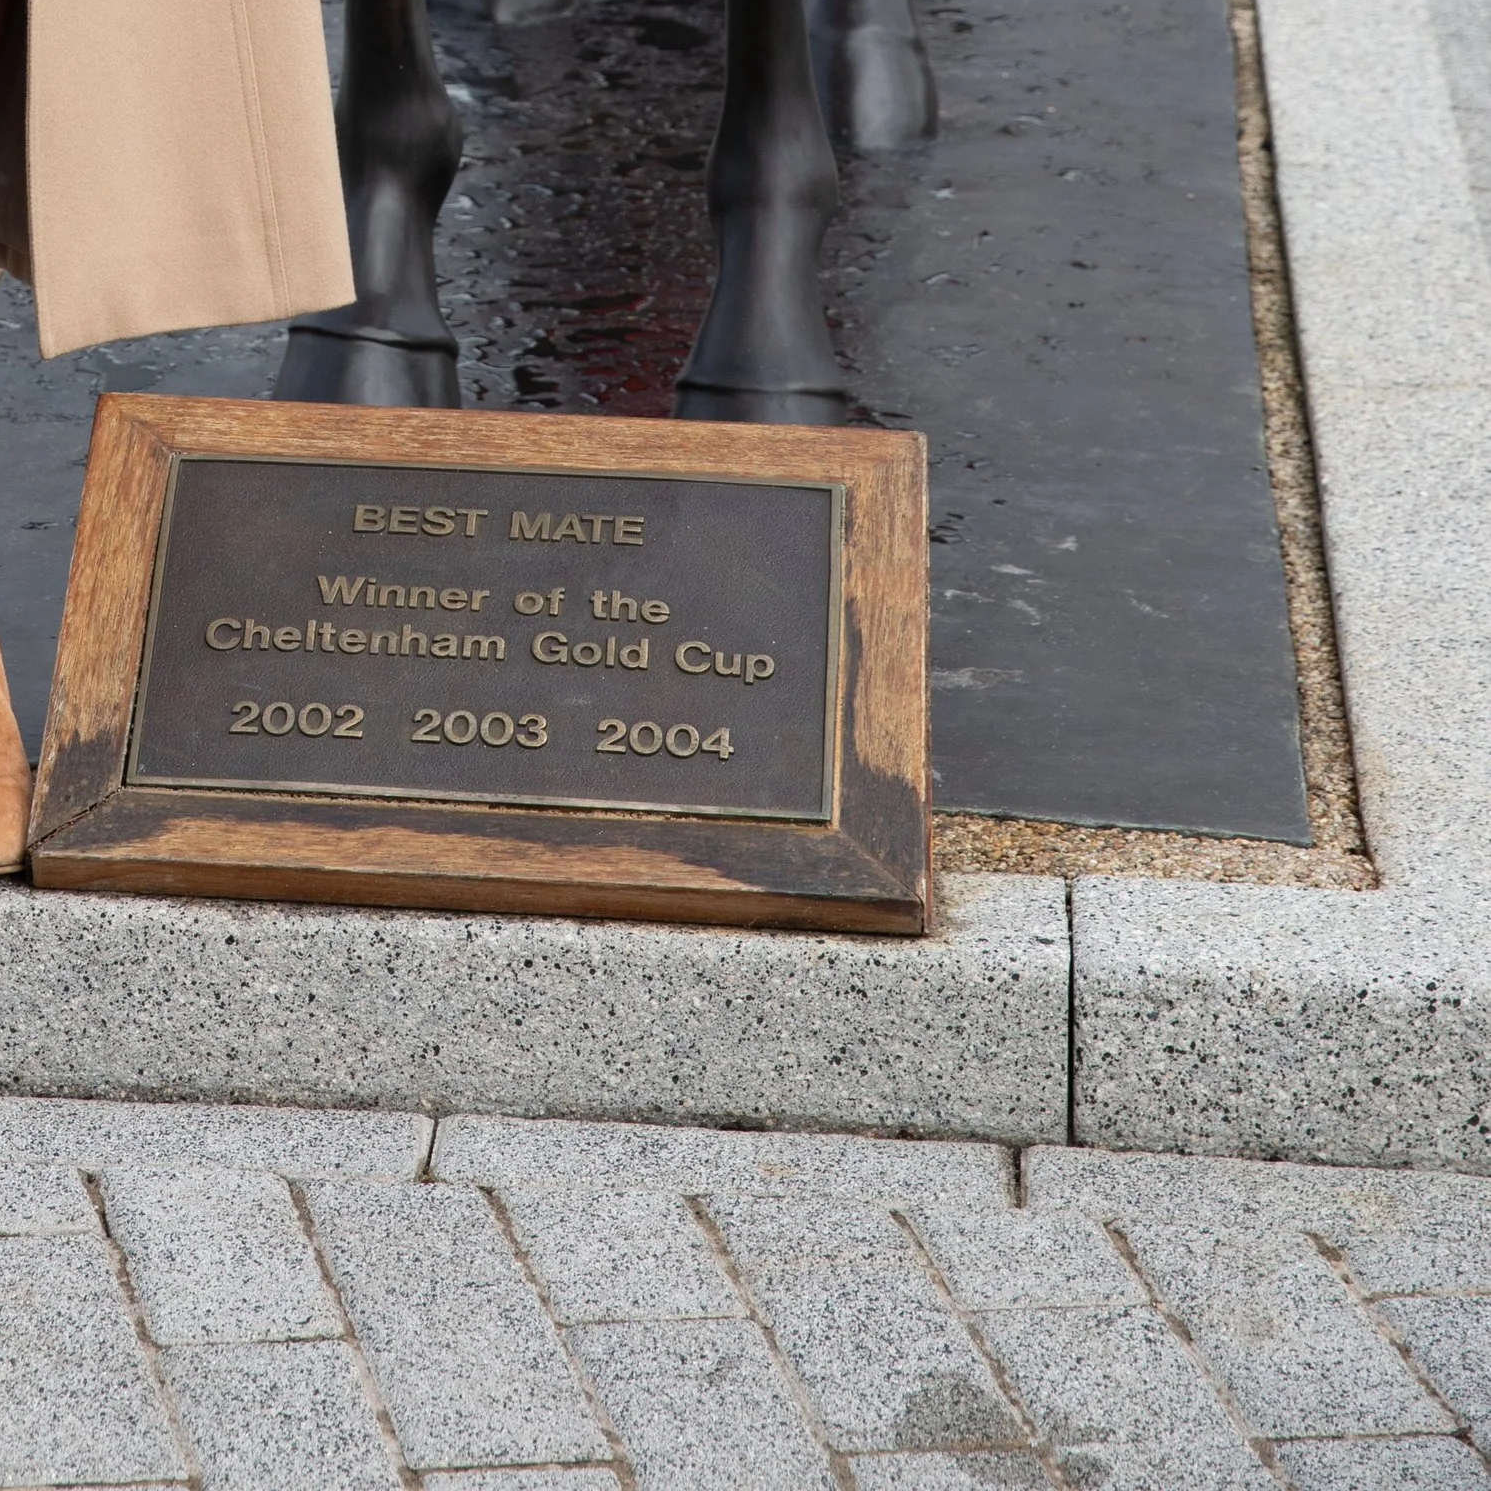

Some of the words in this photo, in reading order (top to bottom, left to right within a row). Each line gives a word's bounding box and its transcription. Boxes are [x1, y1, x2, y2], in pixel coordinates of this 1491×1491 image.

[352, 504, 488, 537] BEST
[509, 511, 645, 546] MATE
[316, 574, 490, 611] Winner
[513, 587, 566, 616] of
[590, 590, 671, 624] the
[204, 617, 506, 660] Cheltenham
[530, 631, 649, 670] Gold
[674, 640, 776, 684] Cup
[228, 700, 364, 738] 2002
[411, 708, 549, 748] 2003
[595, 719, 734, 760] 2004
